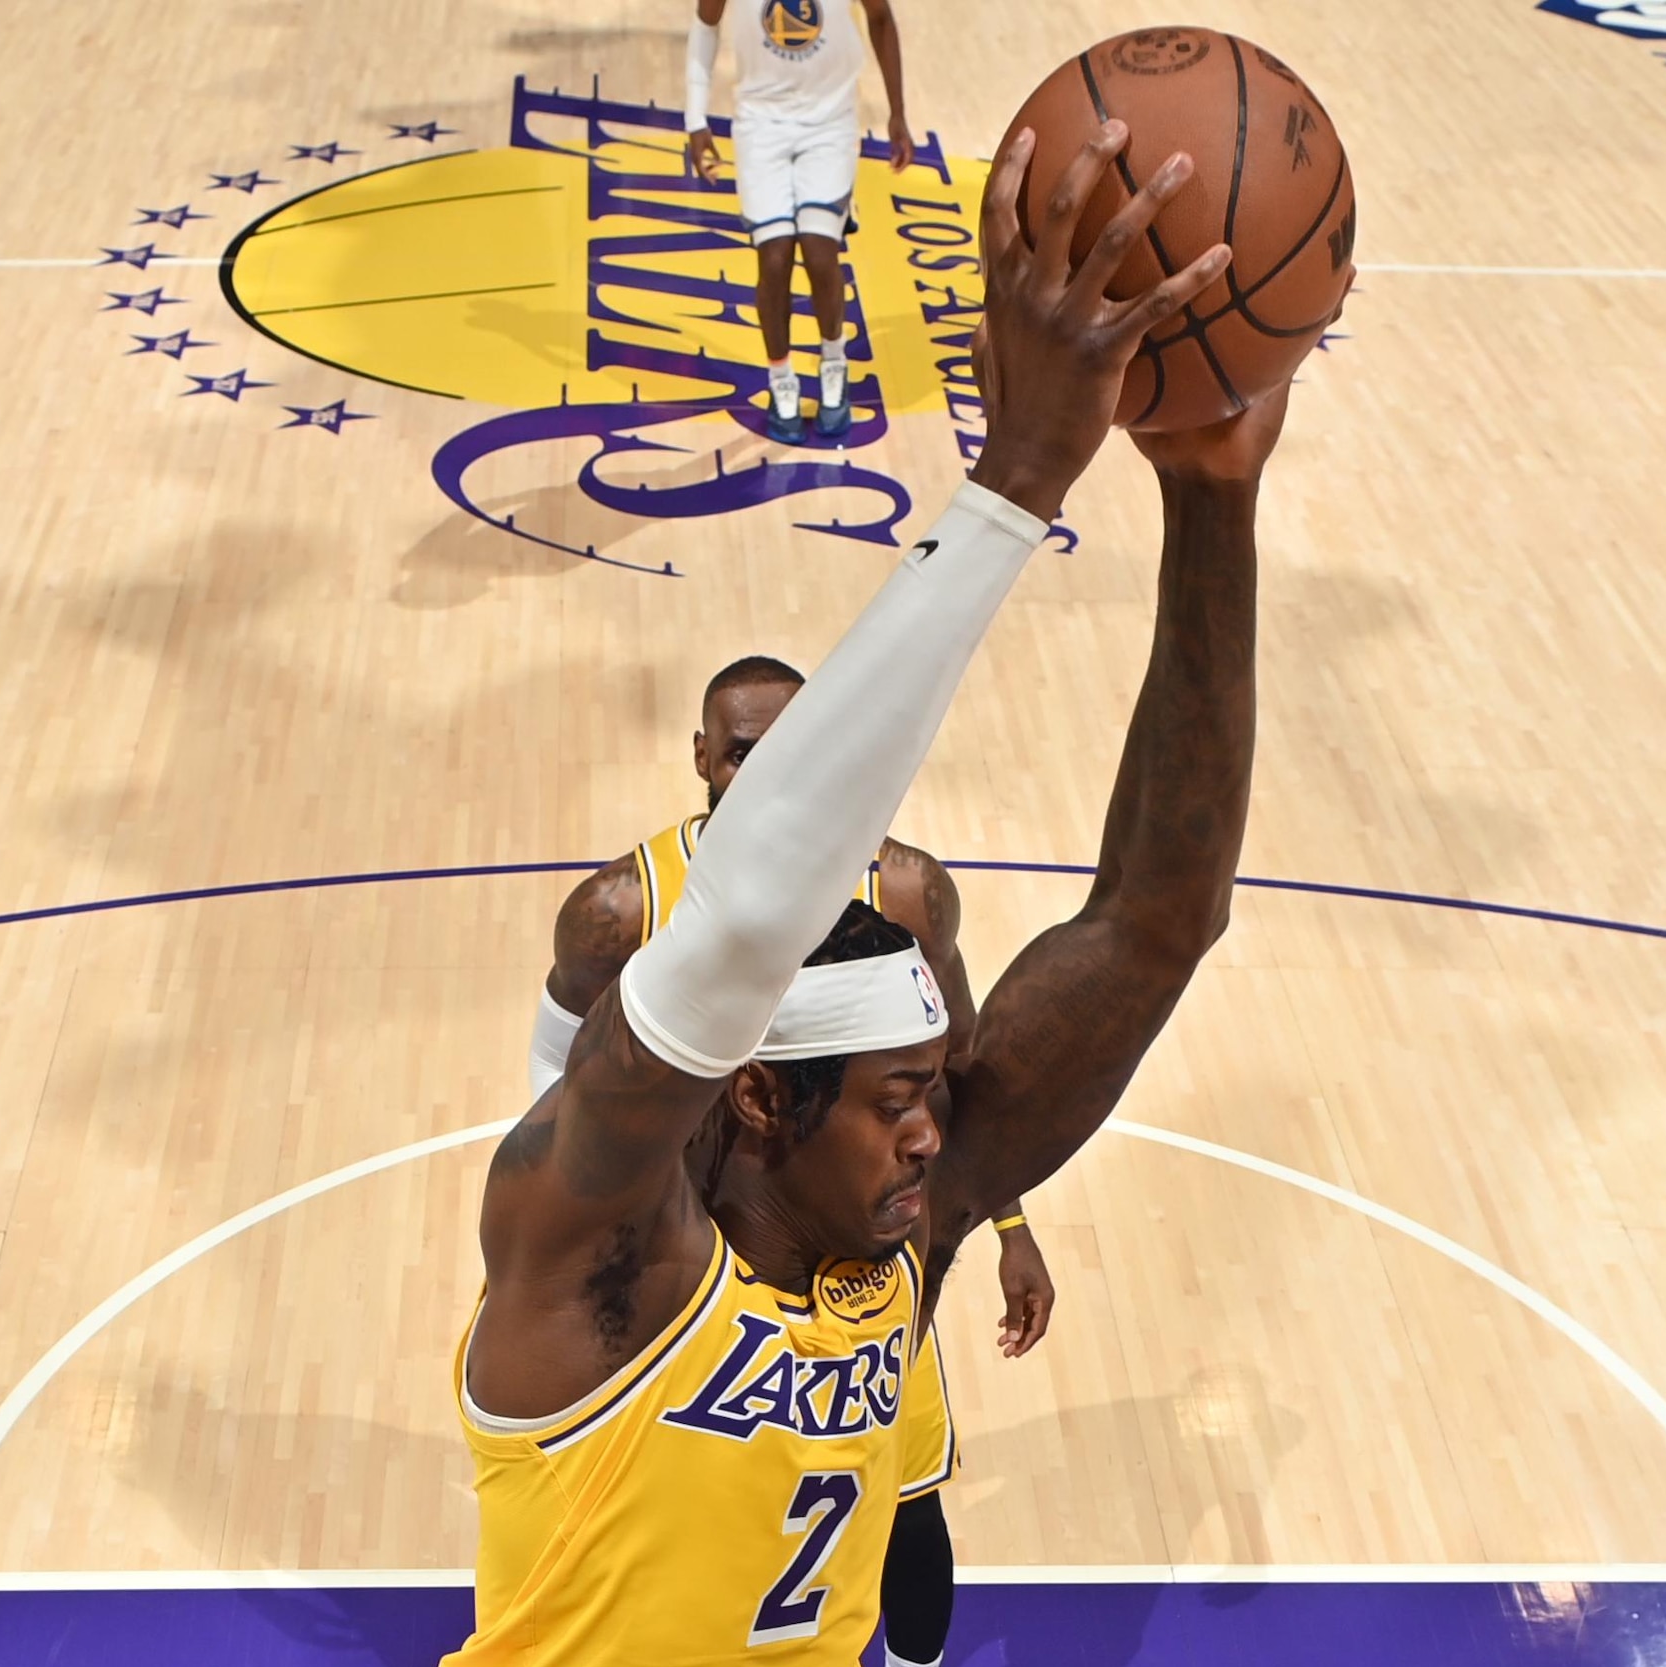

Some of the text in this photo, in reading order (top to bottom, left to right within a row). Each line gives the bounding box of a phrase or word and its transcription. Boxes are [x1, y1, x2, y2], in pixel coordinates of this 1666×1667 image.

[890, 193, 983, 276] LOS
[431, 73, 952, 577] LAKERS
[824, 1261, 894, 1304] bibigo
[846, 1289, 877, 1309] 비비고
[655, 1308, 908, 1443] LAKERS
[746, 1469, 864, 1648] 2
